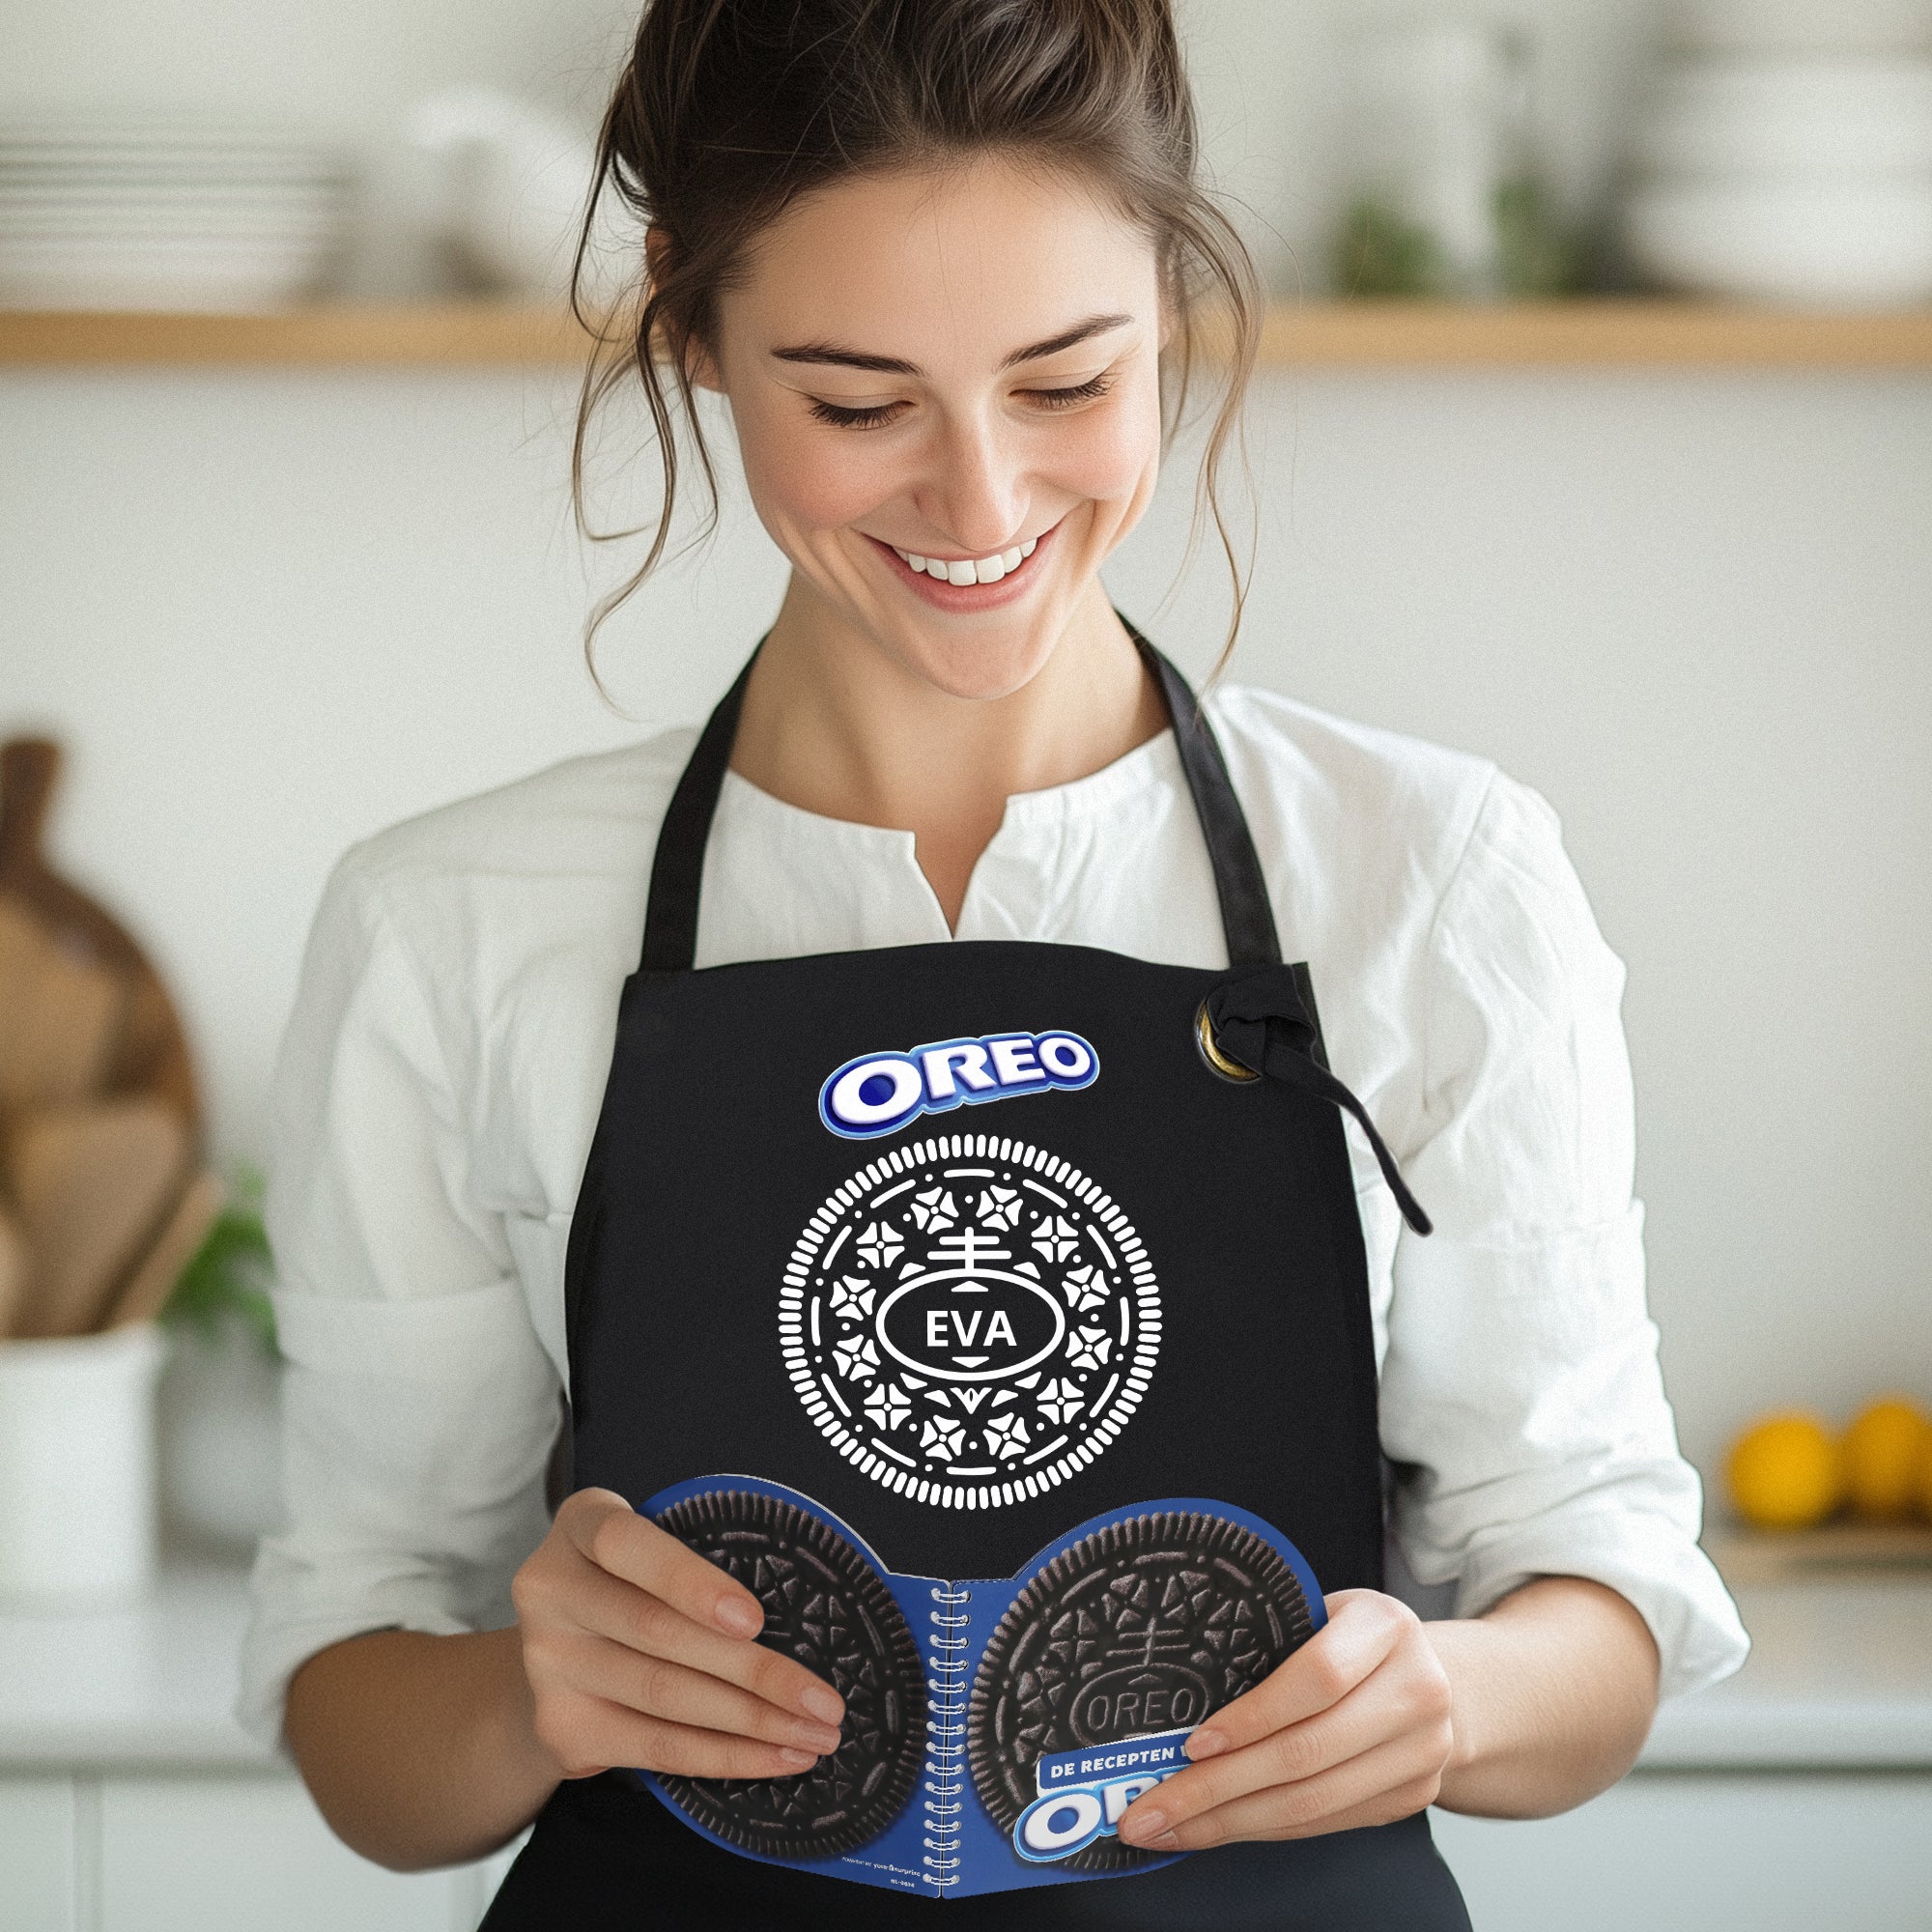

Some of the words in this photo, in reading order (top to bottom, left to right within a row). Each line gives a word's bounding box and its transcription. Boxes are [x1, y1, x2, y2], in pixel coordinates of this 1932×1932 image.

[832, 1037, 1091, 1124] OREO
[926, 1310, 1017, 1347] EVA
[1087, 1689, 1194, 1731] OREO
[1050, 1763, 1075, 1778] DE
[1080, 1747, 1175, 1774] RECEPTEN
[1025, 1774, 1177, 1850] OR
